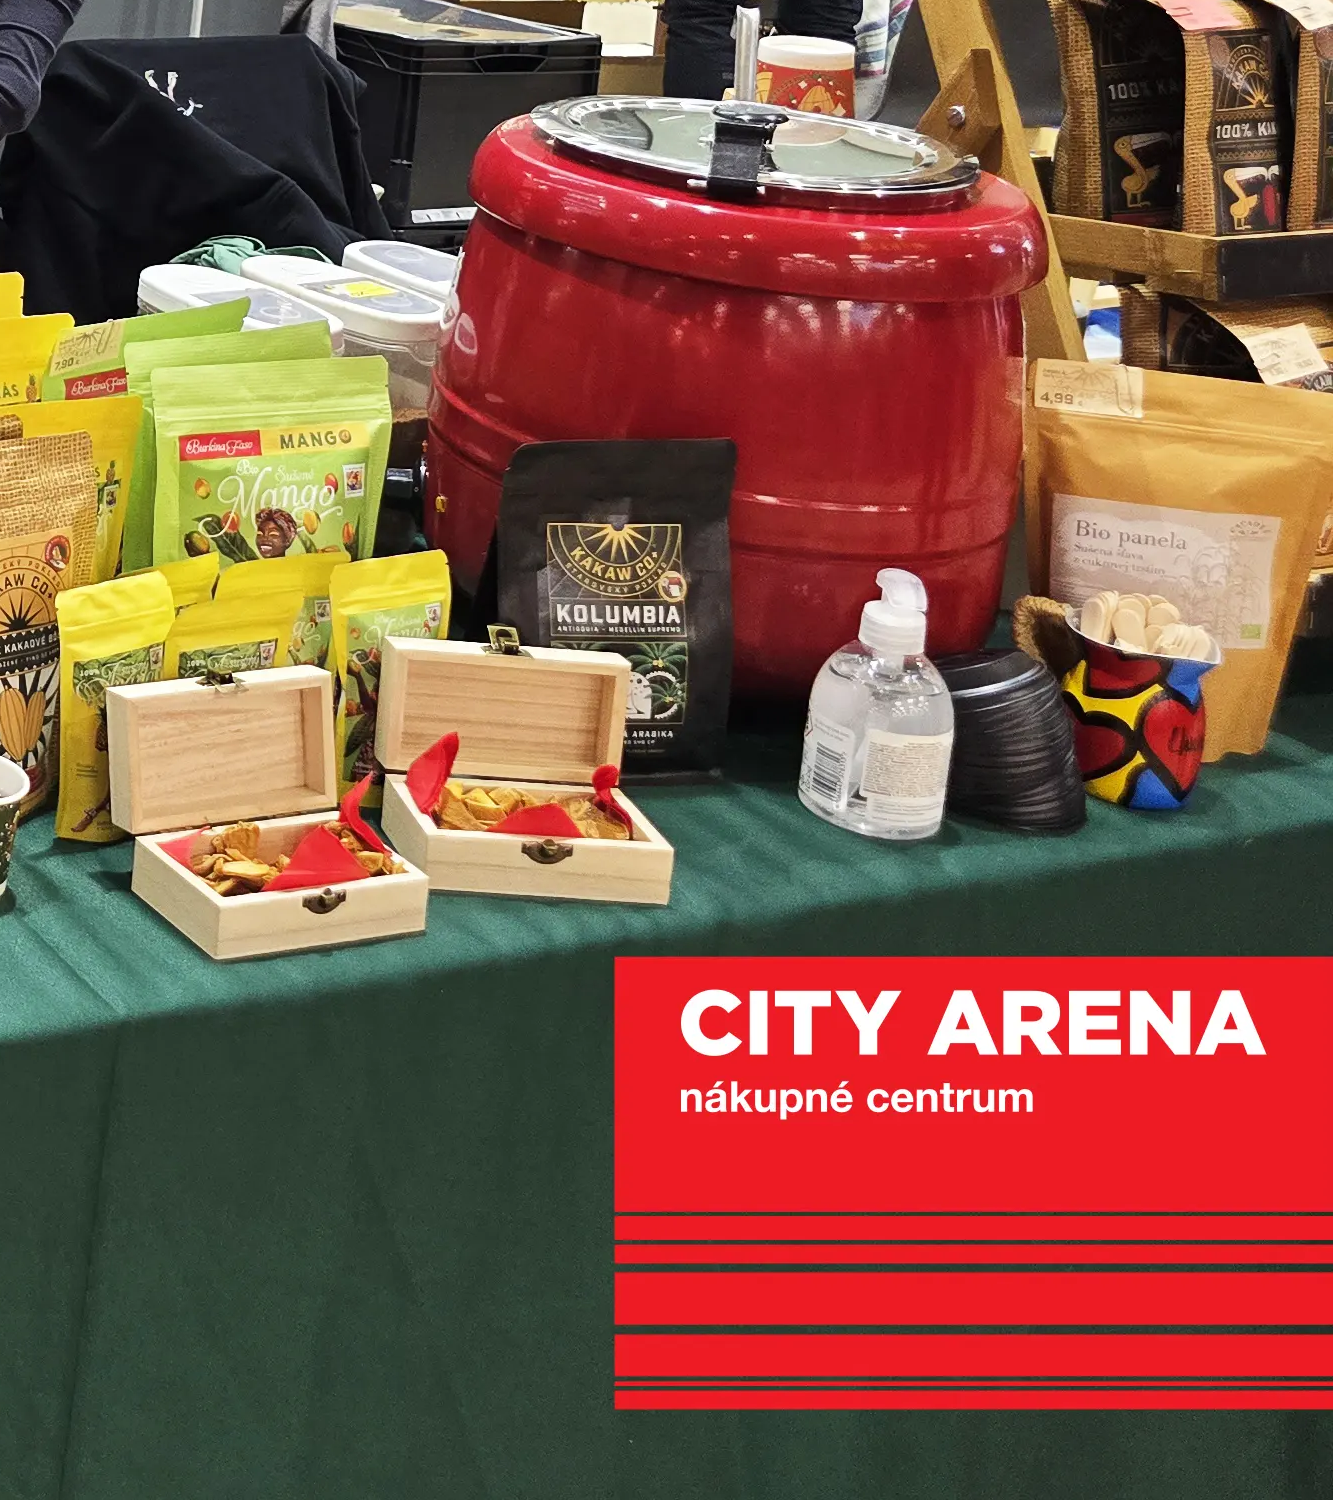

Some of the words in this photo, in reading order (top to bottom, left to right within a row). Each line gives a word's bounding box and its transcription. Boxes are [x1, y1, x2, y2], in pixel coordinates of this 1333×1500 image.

[1215, 122, 1256, 139] 100%
[54, 358, 75, 370] 7,90
[1040, 390, 1074, 405] 4,99
[184, 437, 226, 456] Burkina
[226, 439, 254, 457] Faso
[279, 428, 353, 450] MANGO
[235, 458, 260, 477] Bio
[199, 467, 344, 537] Mango
[1075, 518, 1112, 542] Bio
[1118, 528, 1188, 552] panela
[570, 546, 632, 580] KAKAW
[556, 603, 681, 625] KOLUMBIA
[4, 638, 46, 656] KAKAOVÉ
[632, 730, 674, 739] ARABIKA
